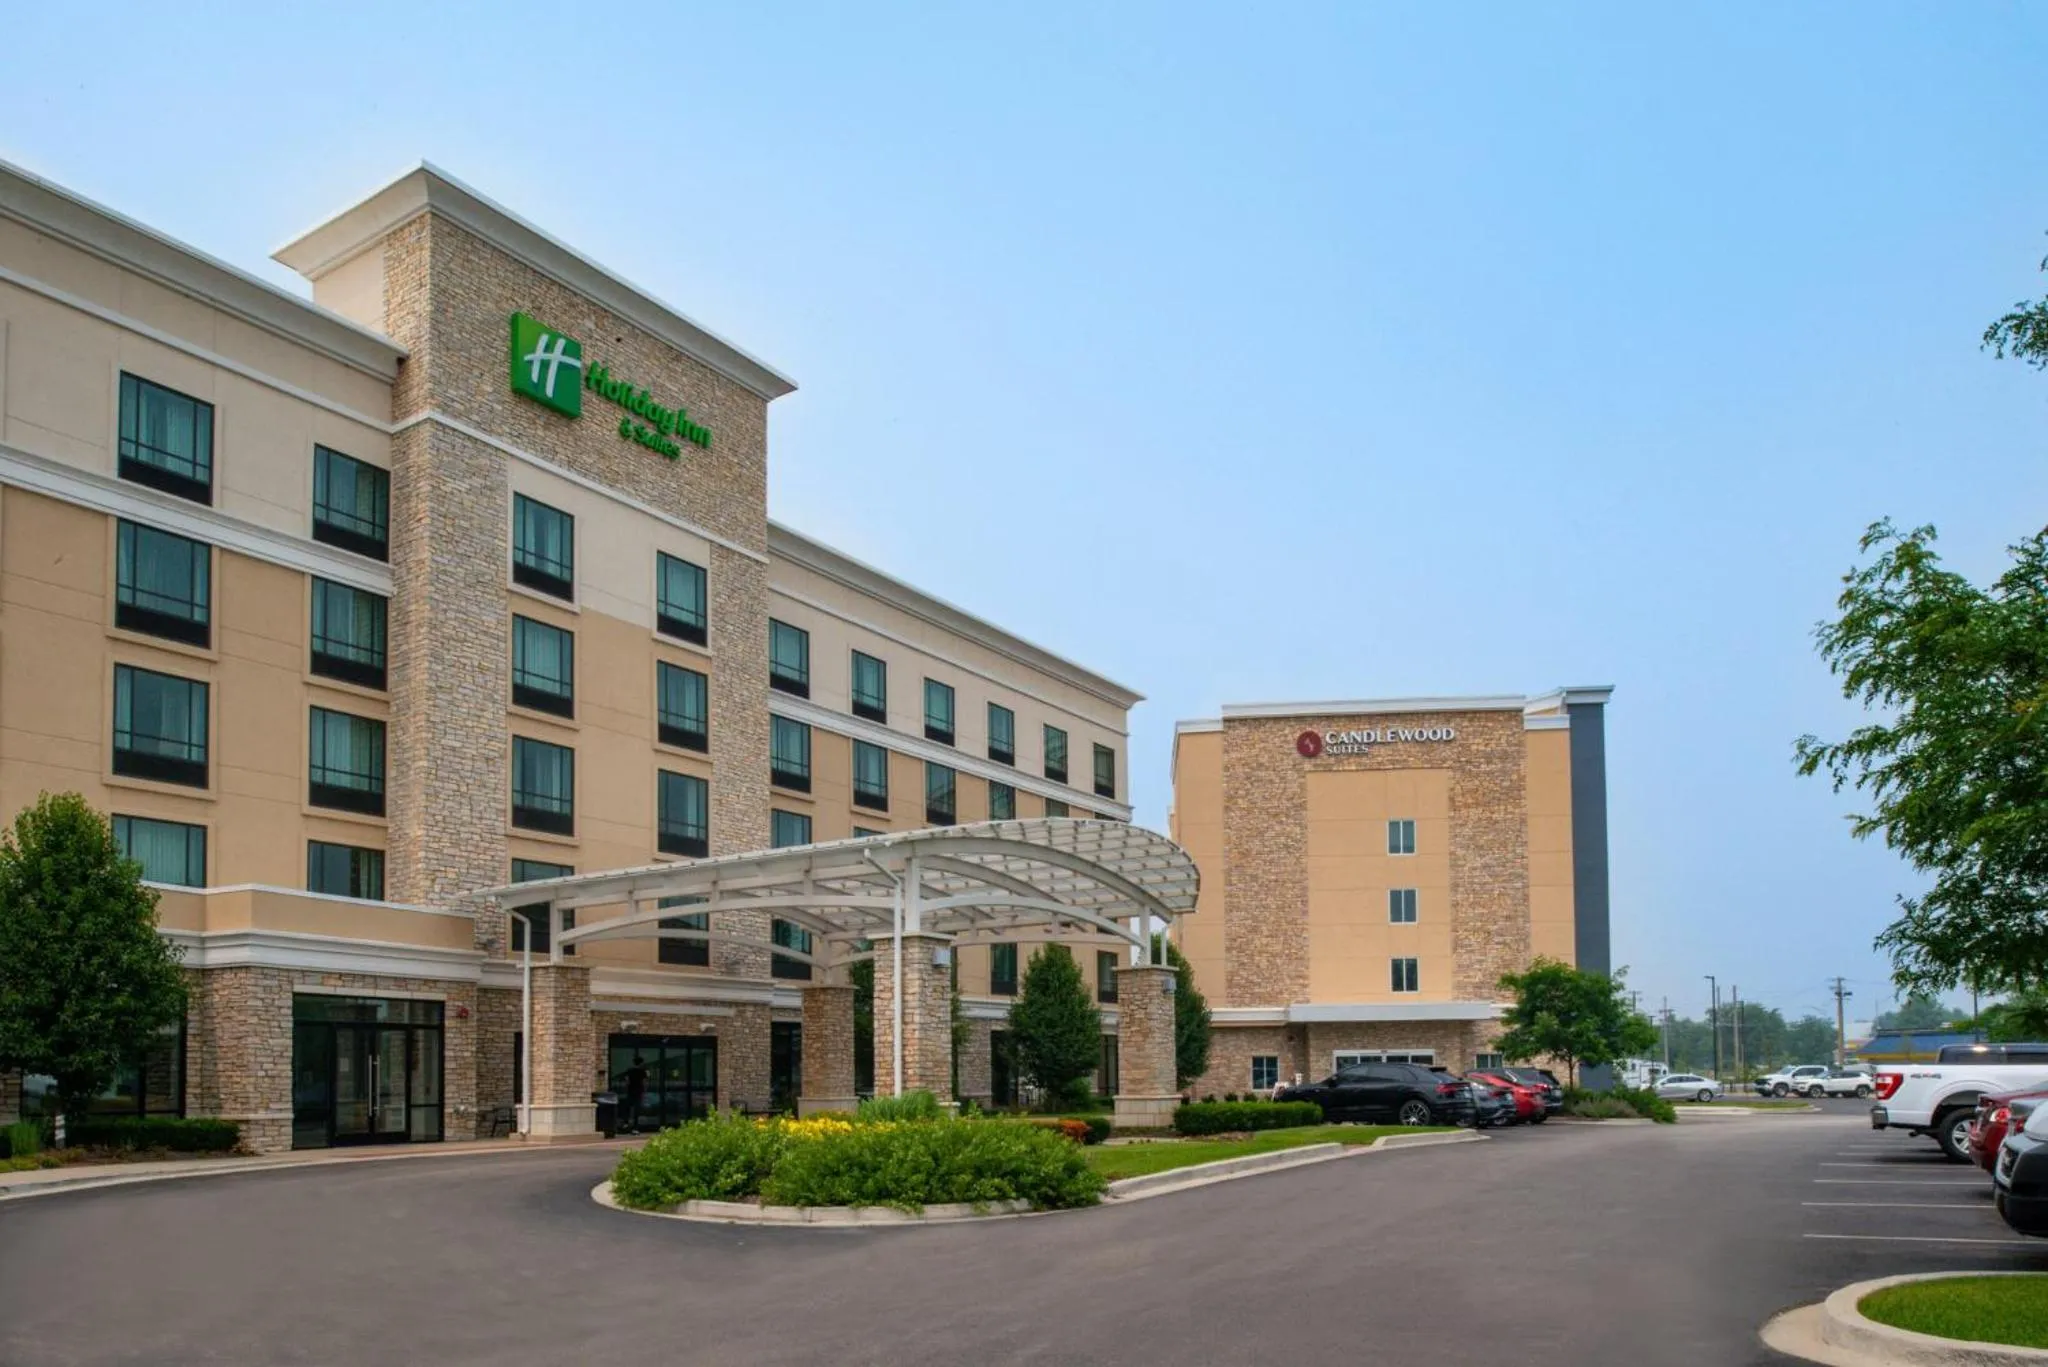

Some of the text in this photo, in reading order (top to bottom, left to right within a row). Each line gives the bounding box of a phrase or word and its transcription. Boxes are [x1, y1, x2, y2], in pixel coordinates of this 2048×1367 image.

[585, 360, 712, 449] Holiday Inn
[633, 424, 681, 459] Suites
[1325, 727, 1455, 744] CANDLEWOOD
[1326, 744, 1369, 755] SUITES
